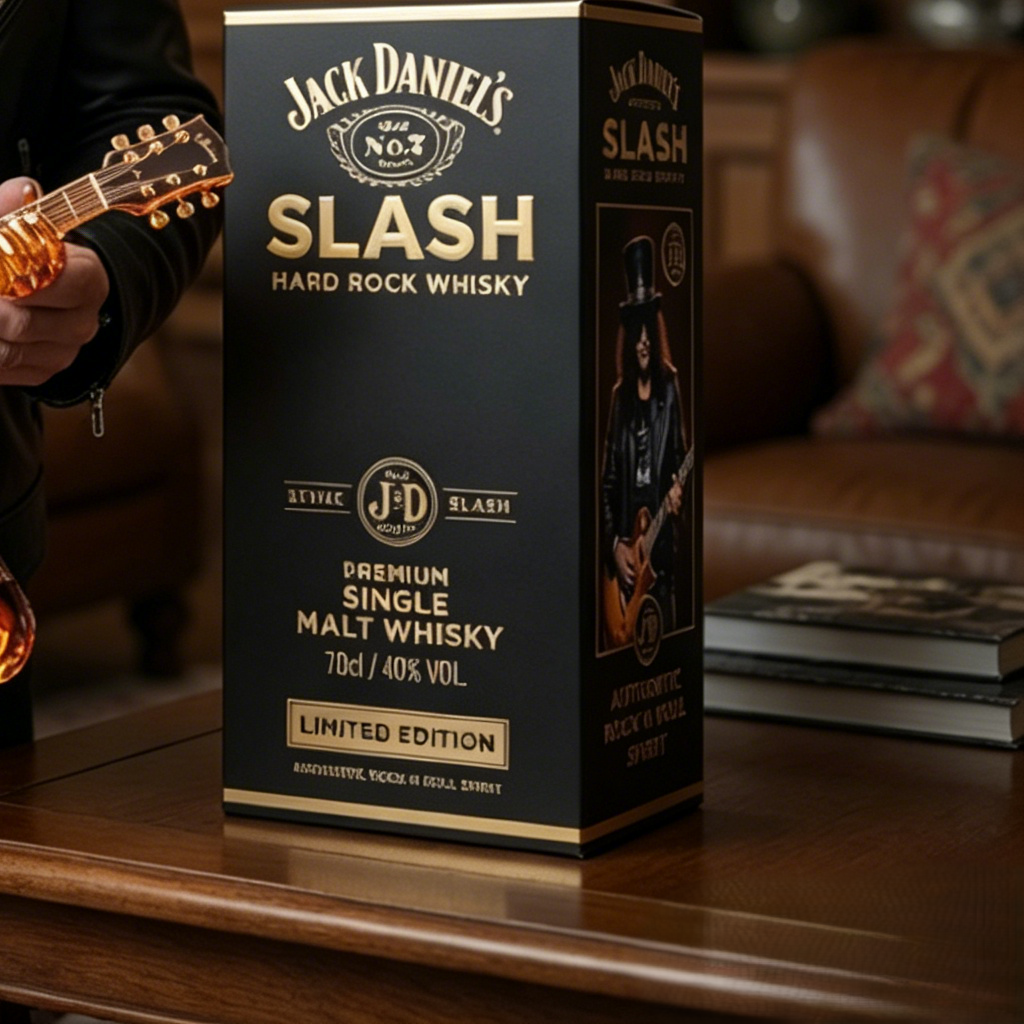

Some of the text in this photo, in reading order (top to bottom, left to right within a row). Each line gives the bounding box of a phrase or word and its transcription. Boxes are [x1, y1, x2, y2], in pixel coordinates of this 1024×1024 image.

[284, 42, 514, 131] JACK DANIEL'S
[602, 116, 688, 164] SLASH
[266, 193, 535, 262] SLASH
[272, 272, 529, 296] HARD ROCK WHISKY
[343, 585, 449, 616] SINGLE
[296, 610, 504, 650] MALT WHISKY
[382, 655, 422, 683] 40%
[300, 715, 495, 753] LIMITED EDITION
